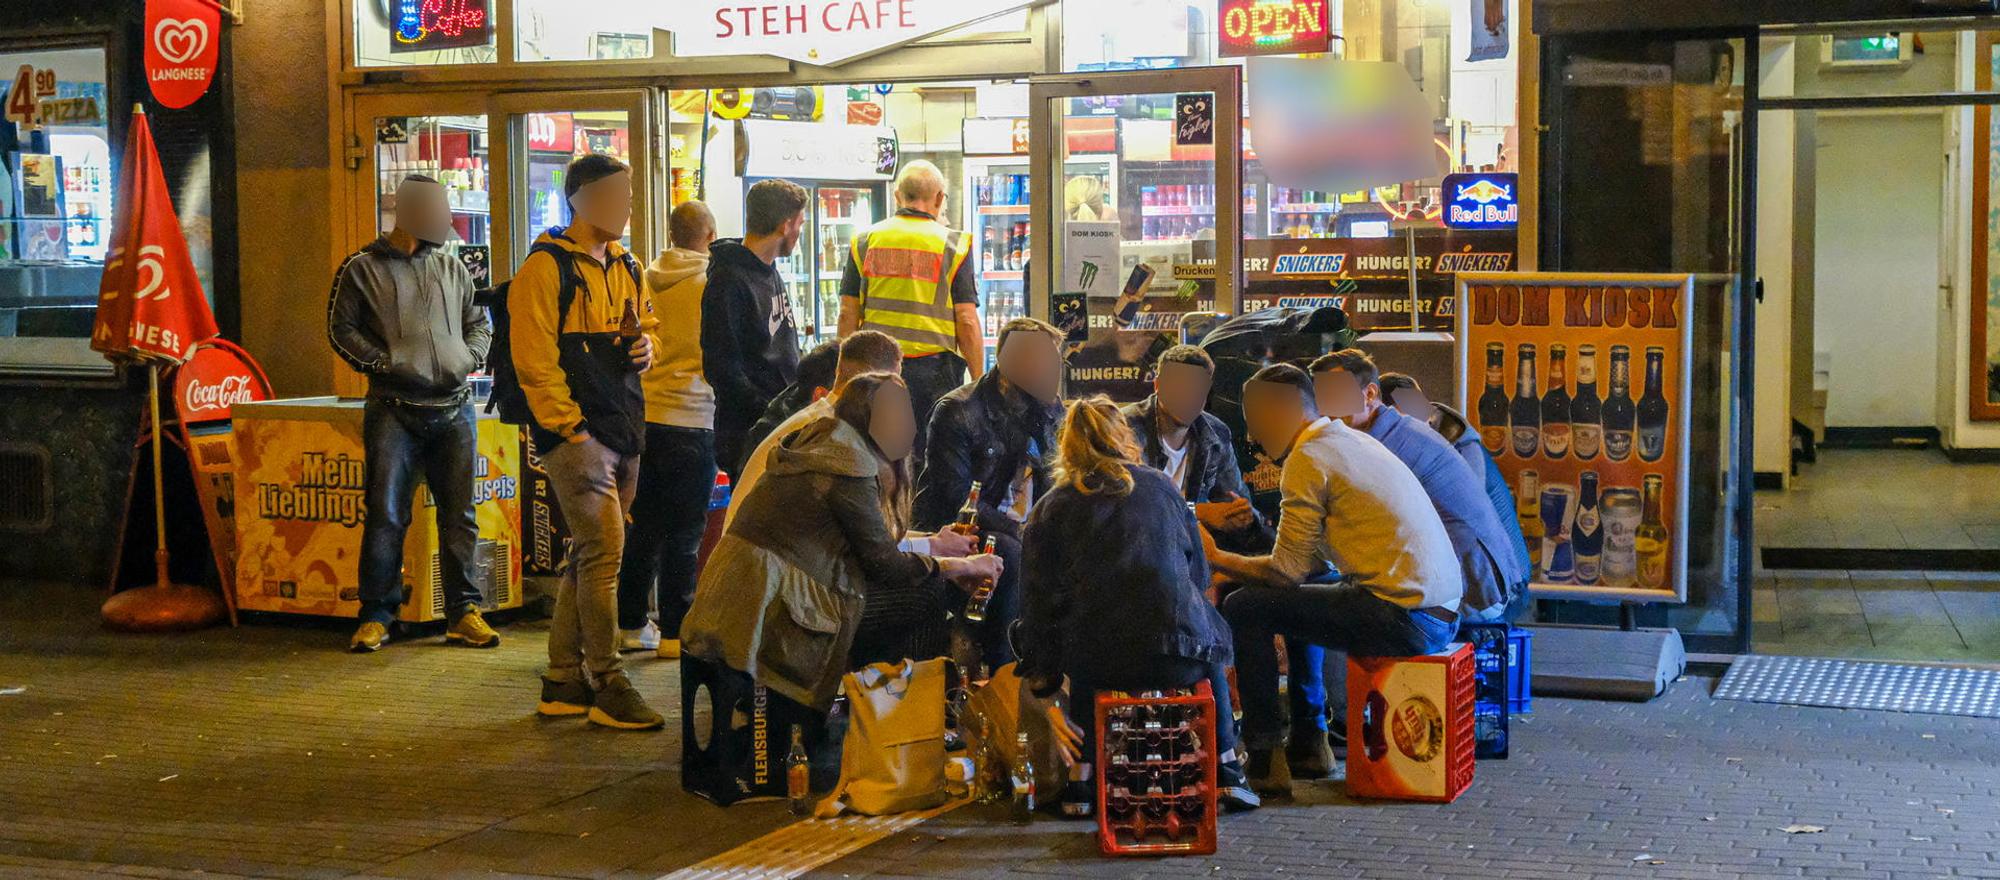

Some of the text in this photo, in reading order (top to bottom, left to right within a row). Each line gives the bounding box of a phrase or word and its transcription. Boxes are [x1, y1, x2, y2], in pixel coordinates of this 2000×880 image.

[420, 0, 484, 36] Coffee
[716, 0, 917, 39] STEH CAFE
[1225, 1, 1322, 38] OPEN
[152, 68, 206, 81] LANGNESE
[10, 71, 35, 124] 4
[41, 98, 100, 123] PIZZA
[1451, 204, 1518, 222] Red Bull
[1072, 230, 1114, 238] DOM KIOSK
[1174, 264, 1216, 277] Drucken
[1275, 254, 1344, 273] SNICKERS
[1439, 253, 1509, 272] SNICKERS
[1356, 299, 1432, 313] HUNGER?
[1474, 284, 1549, 326] DOM
[1564, 285, 1678, 328] KIOSK
[1070, 366, 1141, 381] HUNGER?
[186, 375, 252, 412] Coca-Cola
[300, 452, 365, 489] Mein
[259, 483, 367, 528] Lieblings
[533, 503, 551, 568] SNICKERS
[754, 685, 768, 785] FLENSBURGE
